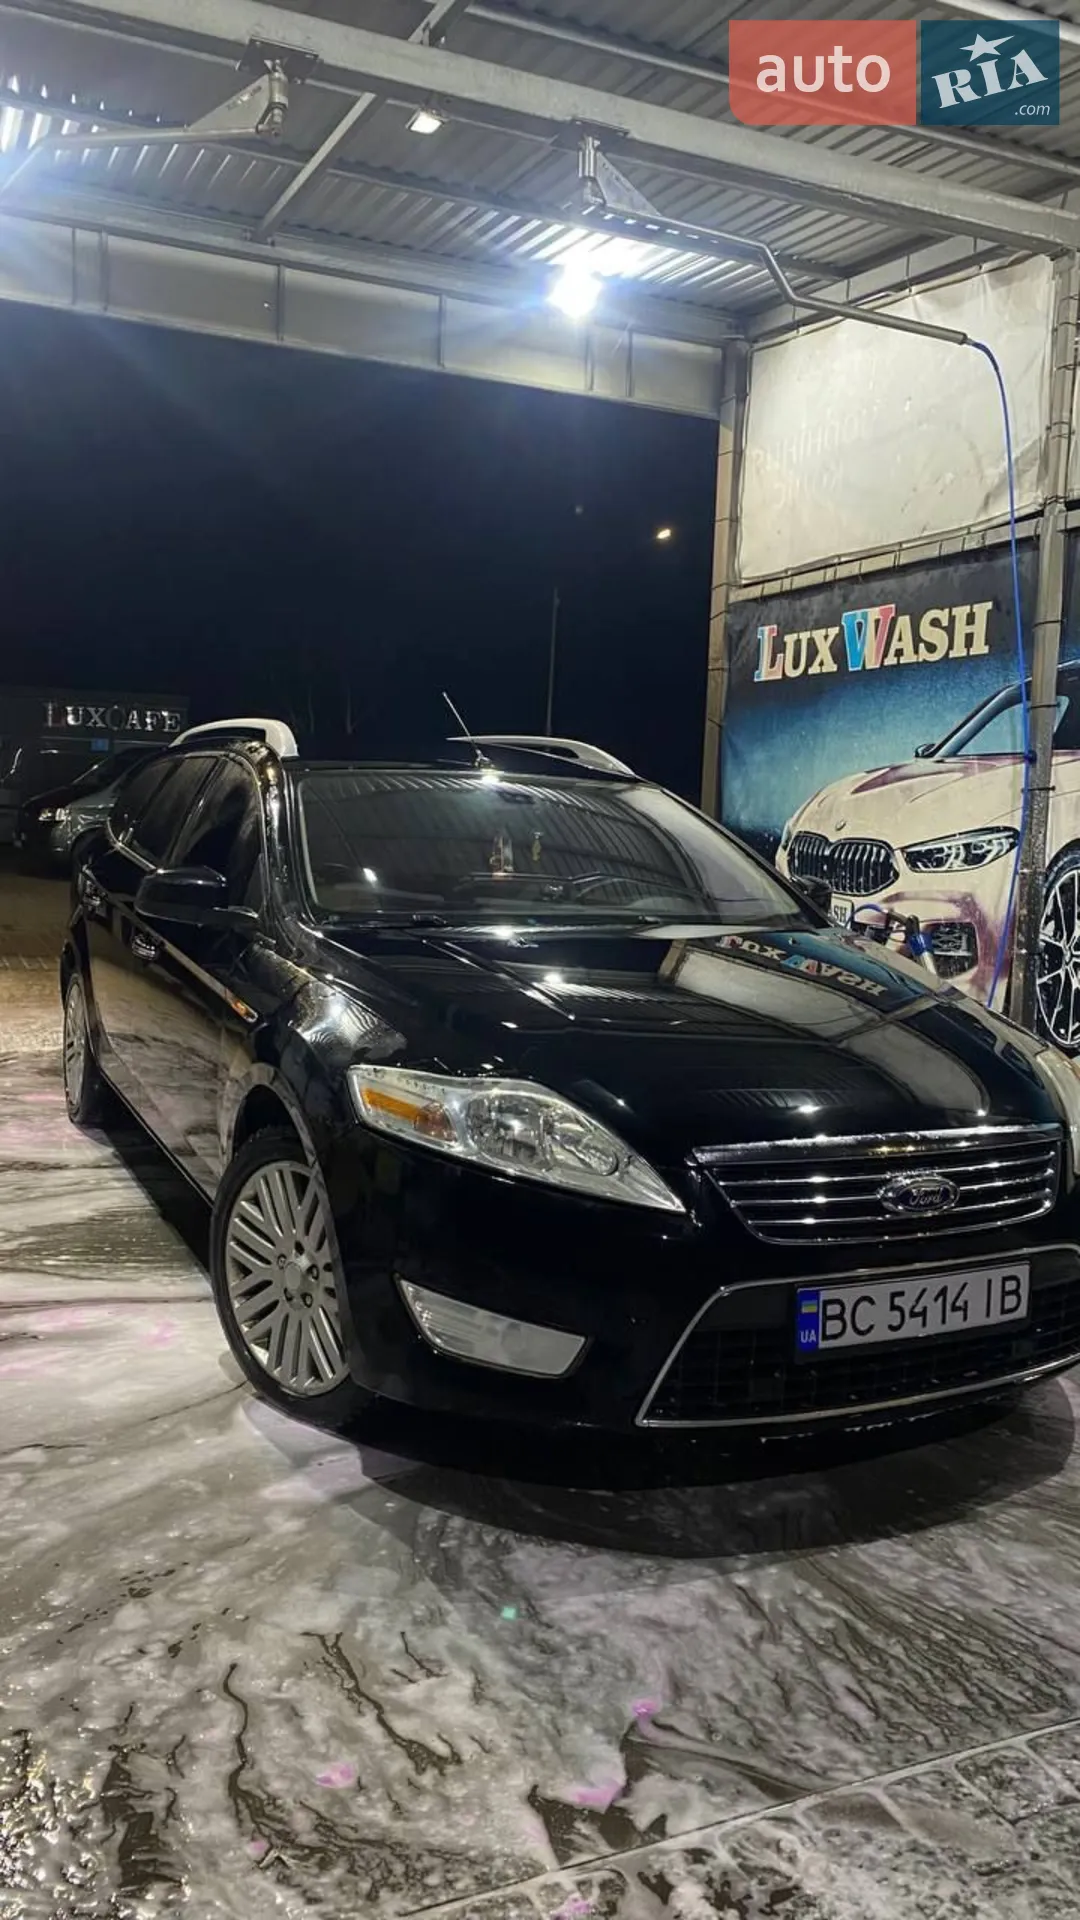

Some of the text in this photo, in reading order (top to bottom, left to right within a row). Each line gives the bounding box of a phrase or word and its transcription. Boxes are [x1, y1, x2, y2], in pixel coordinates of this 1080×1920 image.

[821, 1274, 1022, 1341] BC 5414 IB
[800, 1330, 817, 1343] UA
